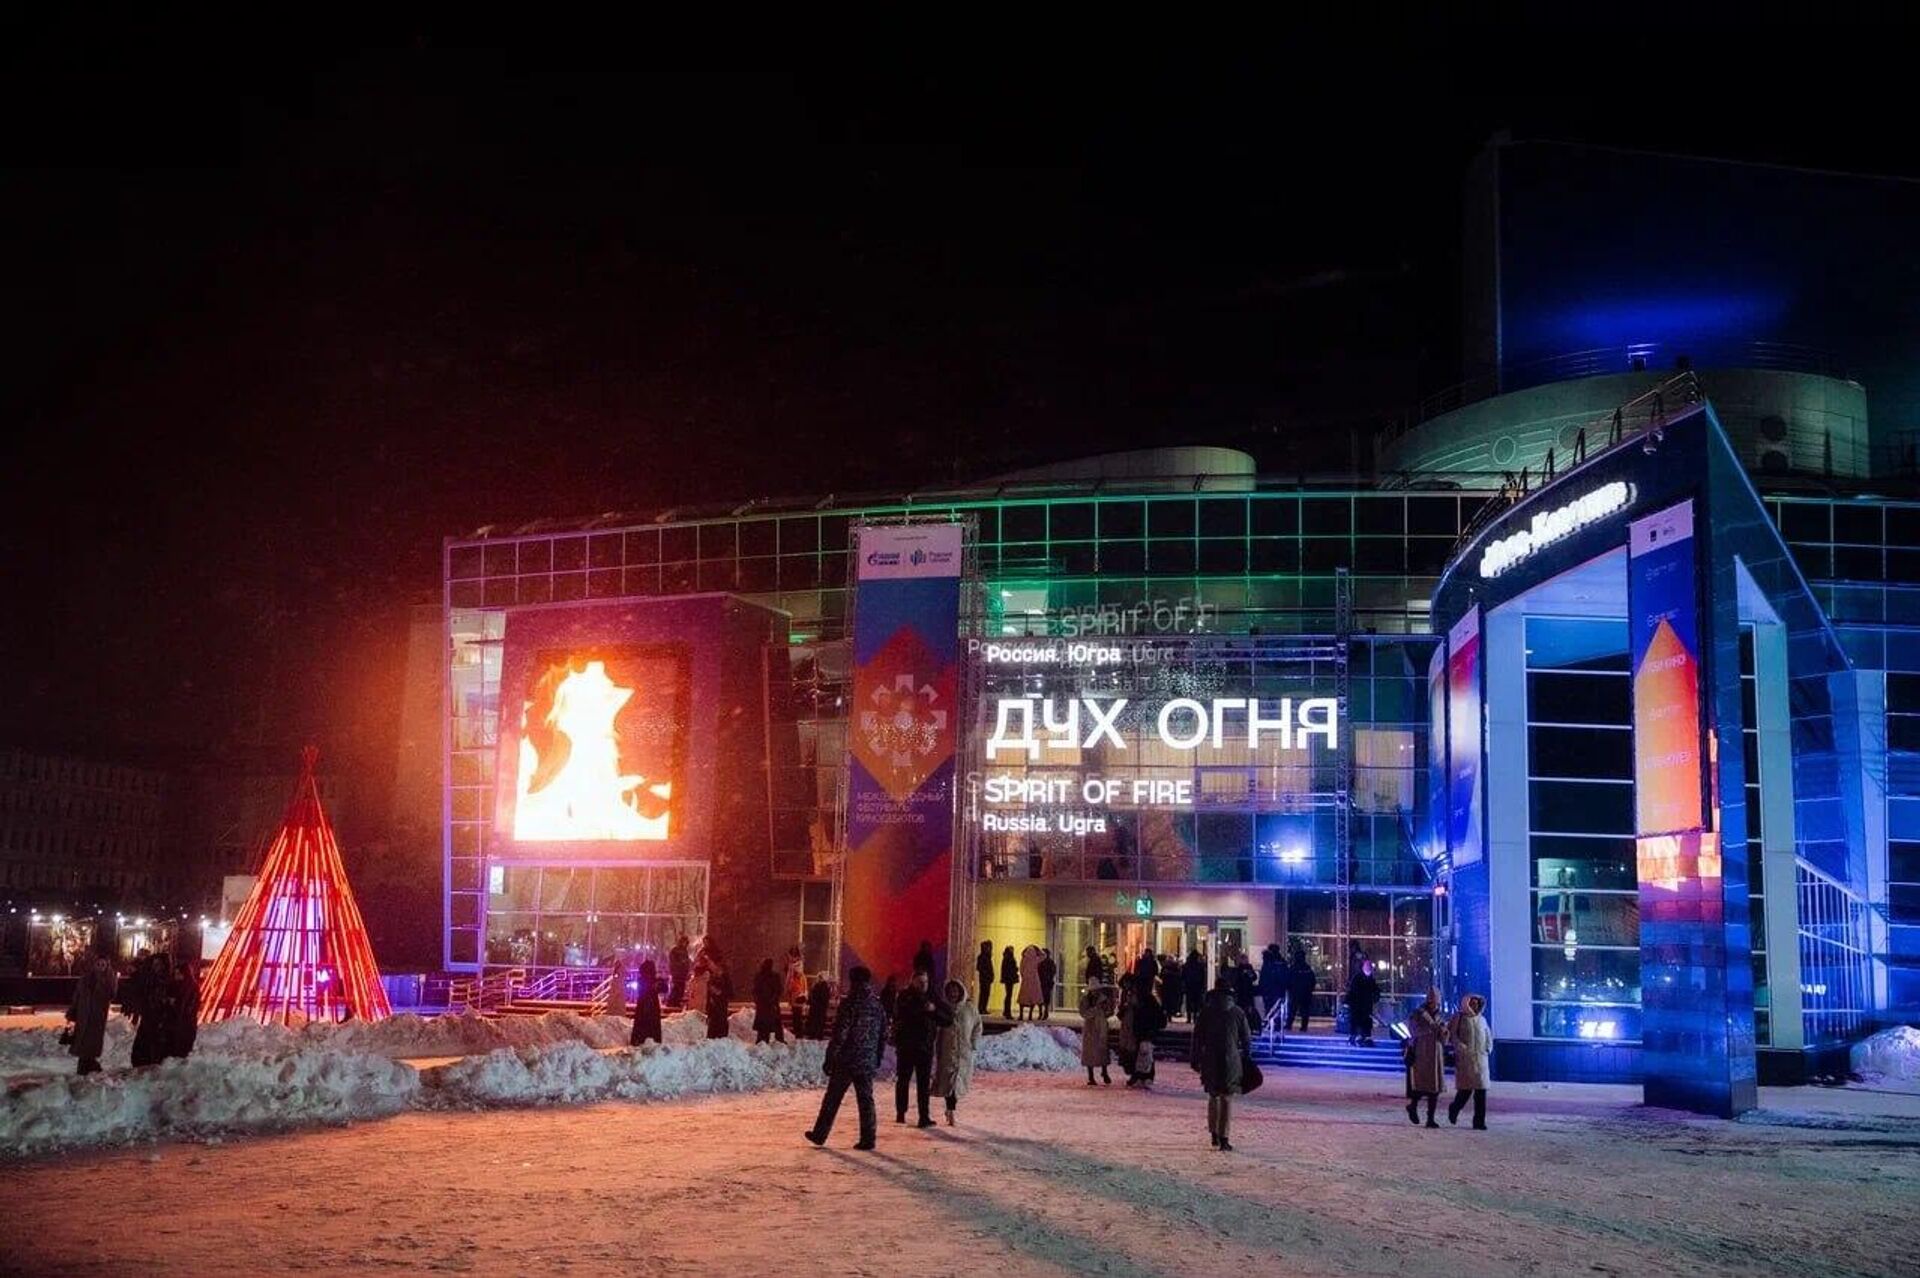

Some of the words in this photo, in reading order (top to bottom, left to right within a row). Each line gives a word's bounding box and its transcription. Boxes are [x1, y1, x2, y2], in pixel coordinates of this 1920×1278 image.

[987, 645, 1060, 663] Россия.
[1067, 644, 1122, 665] Югра
[986, 698, 1129, 760] ДУХ
[1157, 697, 1339, 751] ОГНЯ
[984, 778, 1072, 804] SPIRIT
[1082, 779, 1123, 804] OF
[1133, 779, 1193, 804] FIRE
[983, 813, 1052, 833] Russia.
[1058, 814, 1107, 836] Ugra
